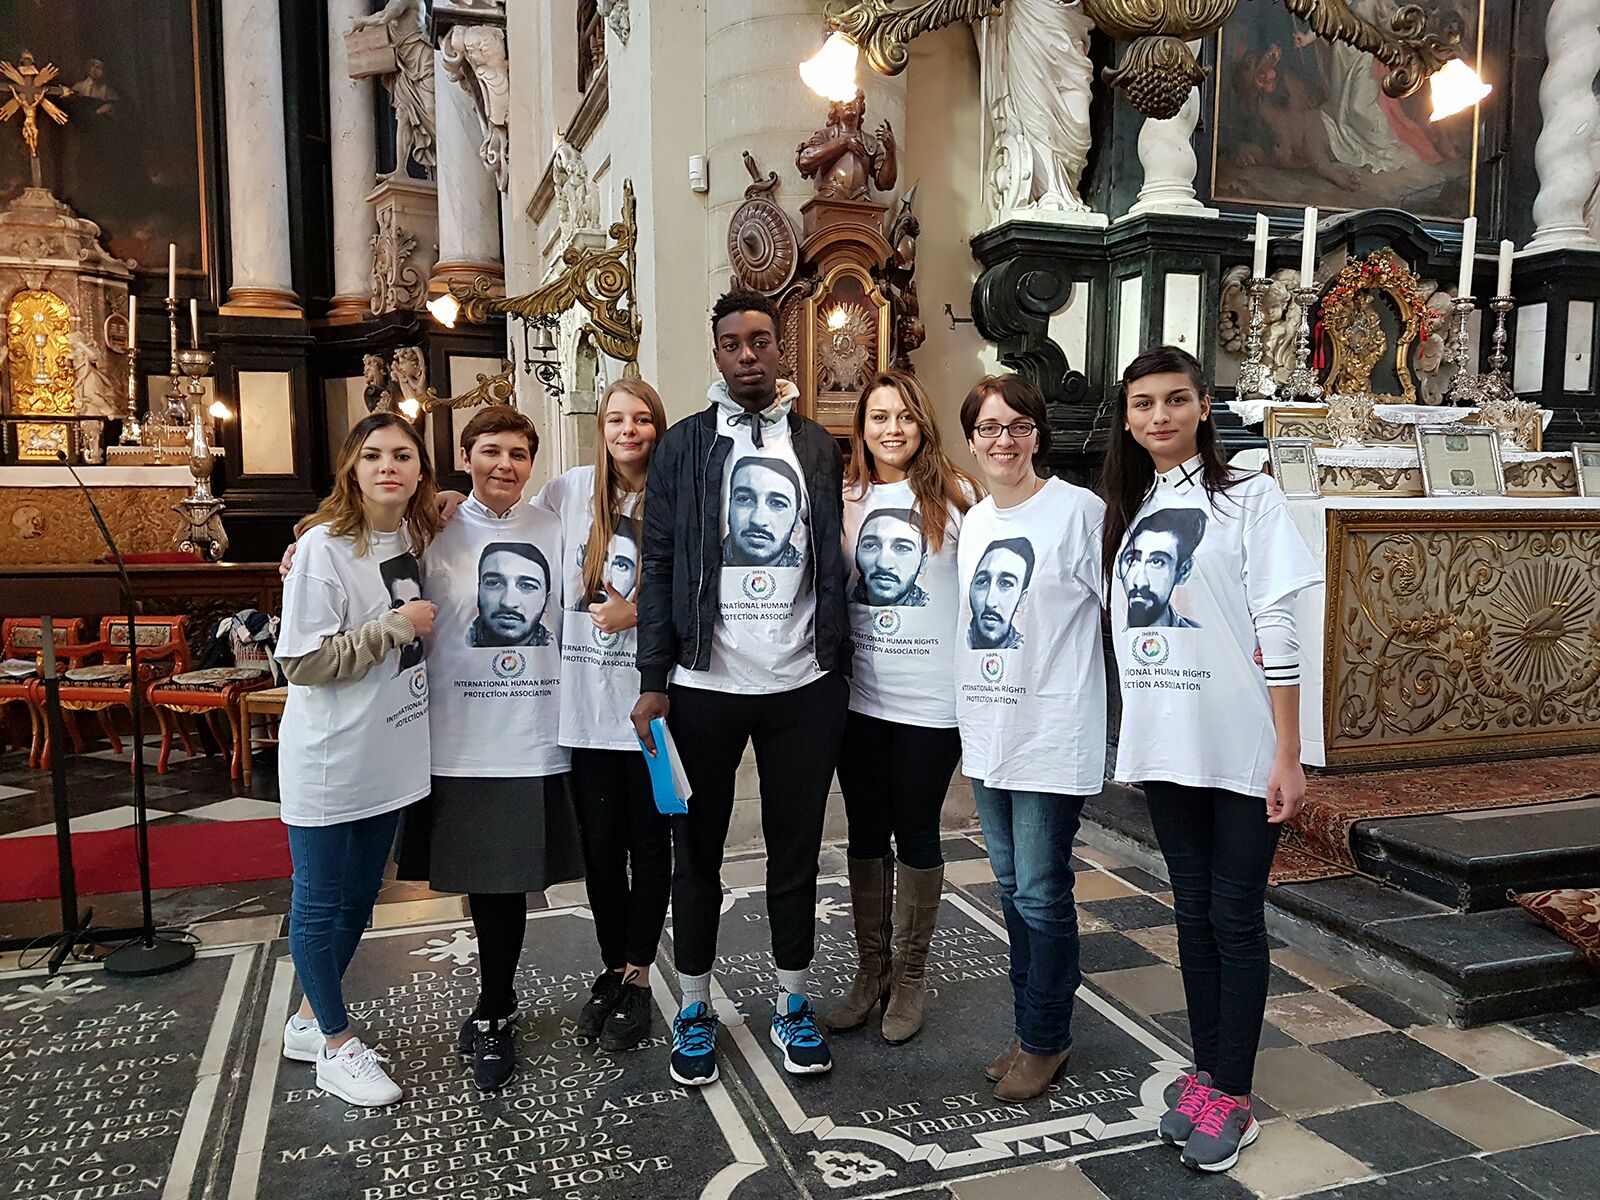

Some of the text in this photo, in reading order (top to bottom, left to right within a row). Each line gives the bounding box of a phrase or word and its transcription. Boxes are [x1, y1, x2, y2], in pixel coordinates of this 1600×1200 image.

[391, 1104, 483, 1132] ENDE
[856, 1101, 924, 1126] DAT
[942, 1091, 982, 1111] SY
[1095, 1066, 1138, 1084] IN
[889, 1085, 1138, 1138] VREDEN AMEN
[279, 1086, 691, 1165] MARGARETA VAN AKEN
[355, 1134, 494, 1169] STERFT
[511, 1120, 579, 1144] DEN
[380, 1145, 520, 1183] MEERT
[550, 1155, 674, 1191] HOEVE
